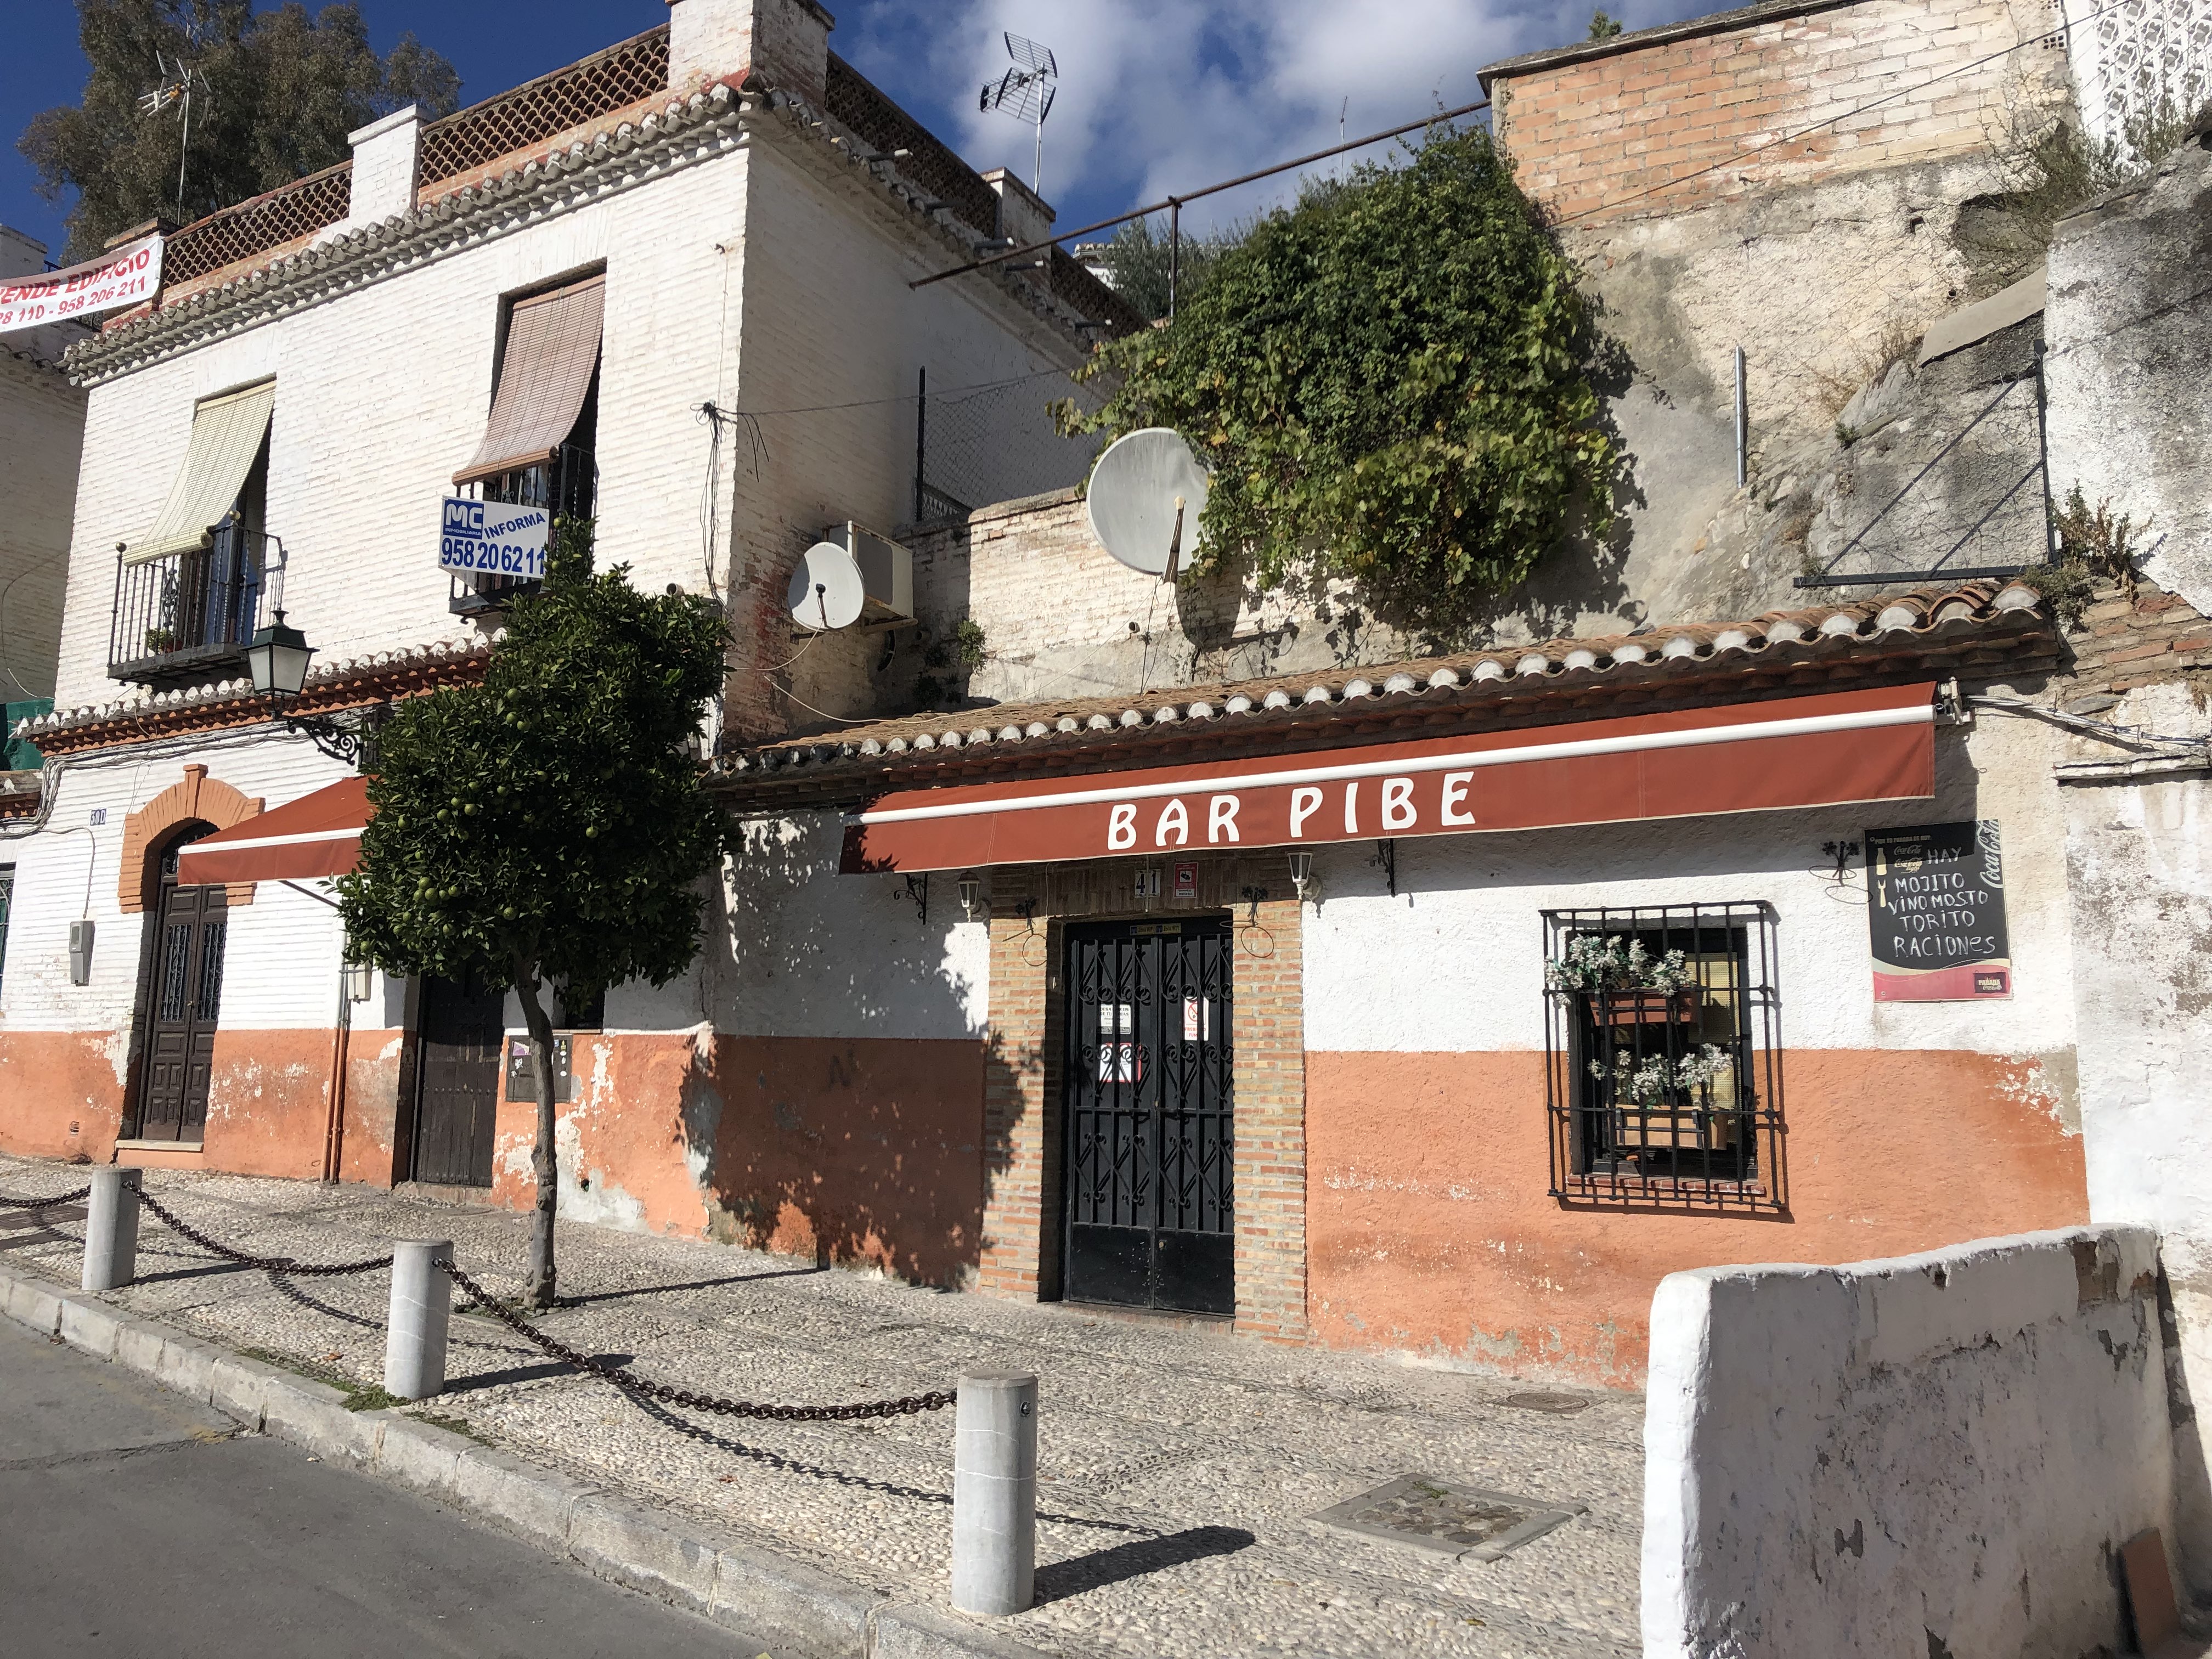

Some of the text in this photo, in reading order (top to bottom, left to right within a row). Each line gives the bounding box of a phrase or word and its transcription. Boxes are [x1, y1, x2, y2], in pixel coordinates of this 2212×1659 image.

[65, 249, 150, 293] EDIFICIO
[19, 304, 44, 322] 110
[58, 295, 84, 315] 958
[87, 286, 115, 307] 206
[117, 276, 145, 296] 211
[445, 503, 483, 529] MC
[484, 512, 546, 539] INFORMA
[445, 527, 481, 536] INMOBILIARIA
[1107, 771, 1476, 850] BAR PIBE
[1927, 847, 1962, 864] HAY
[1136, 873, 1156, 894] 41
[1895, 873, 1965, 893] MOJITO
[1931, 890, 1988, 909] MOSTO
